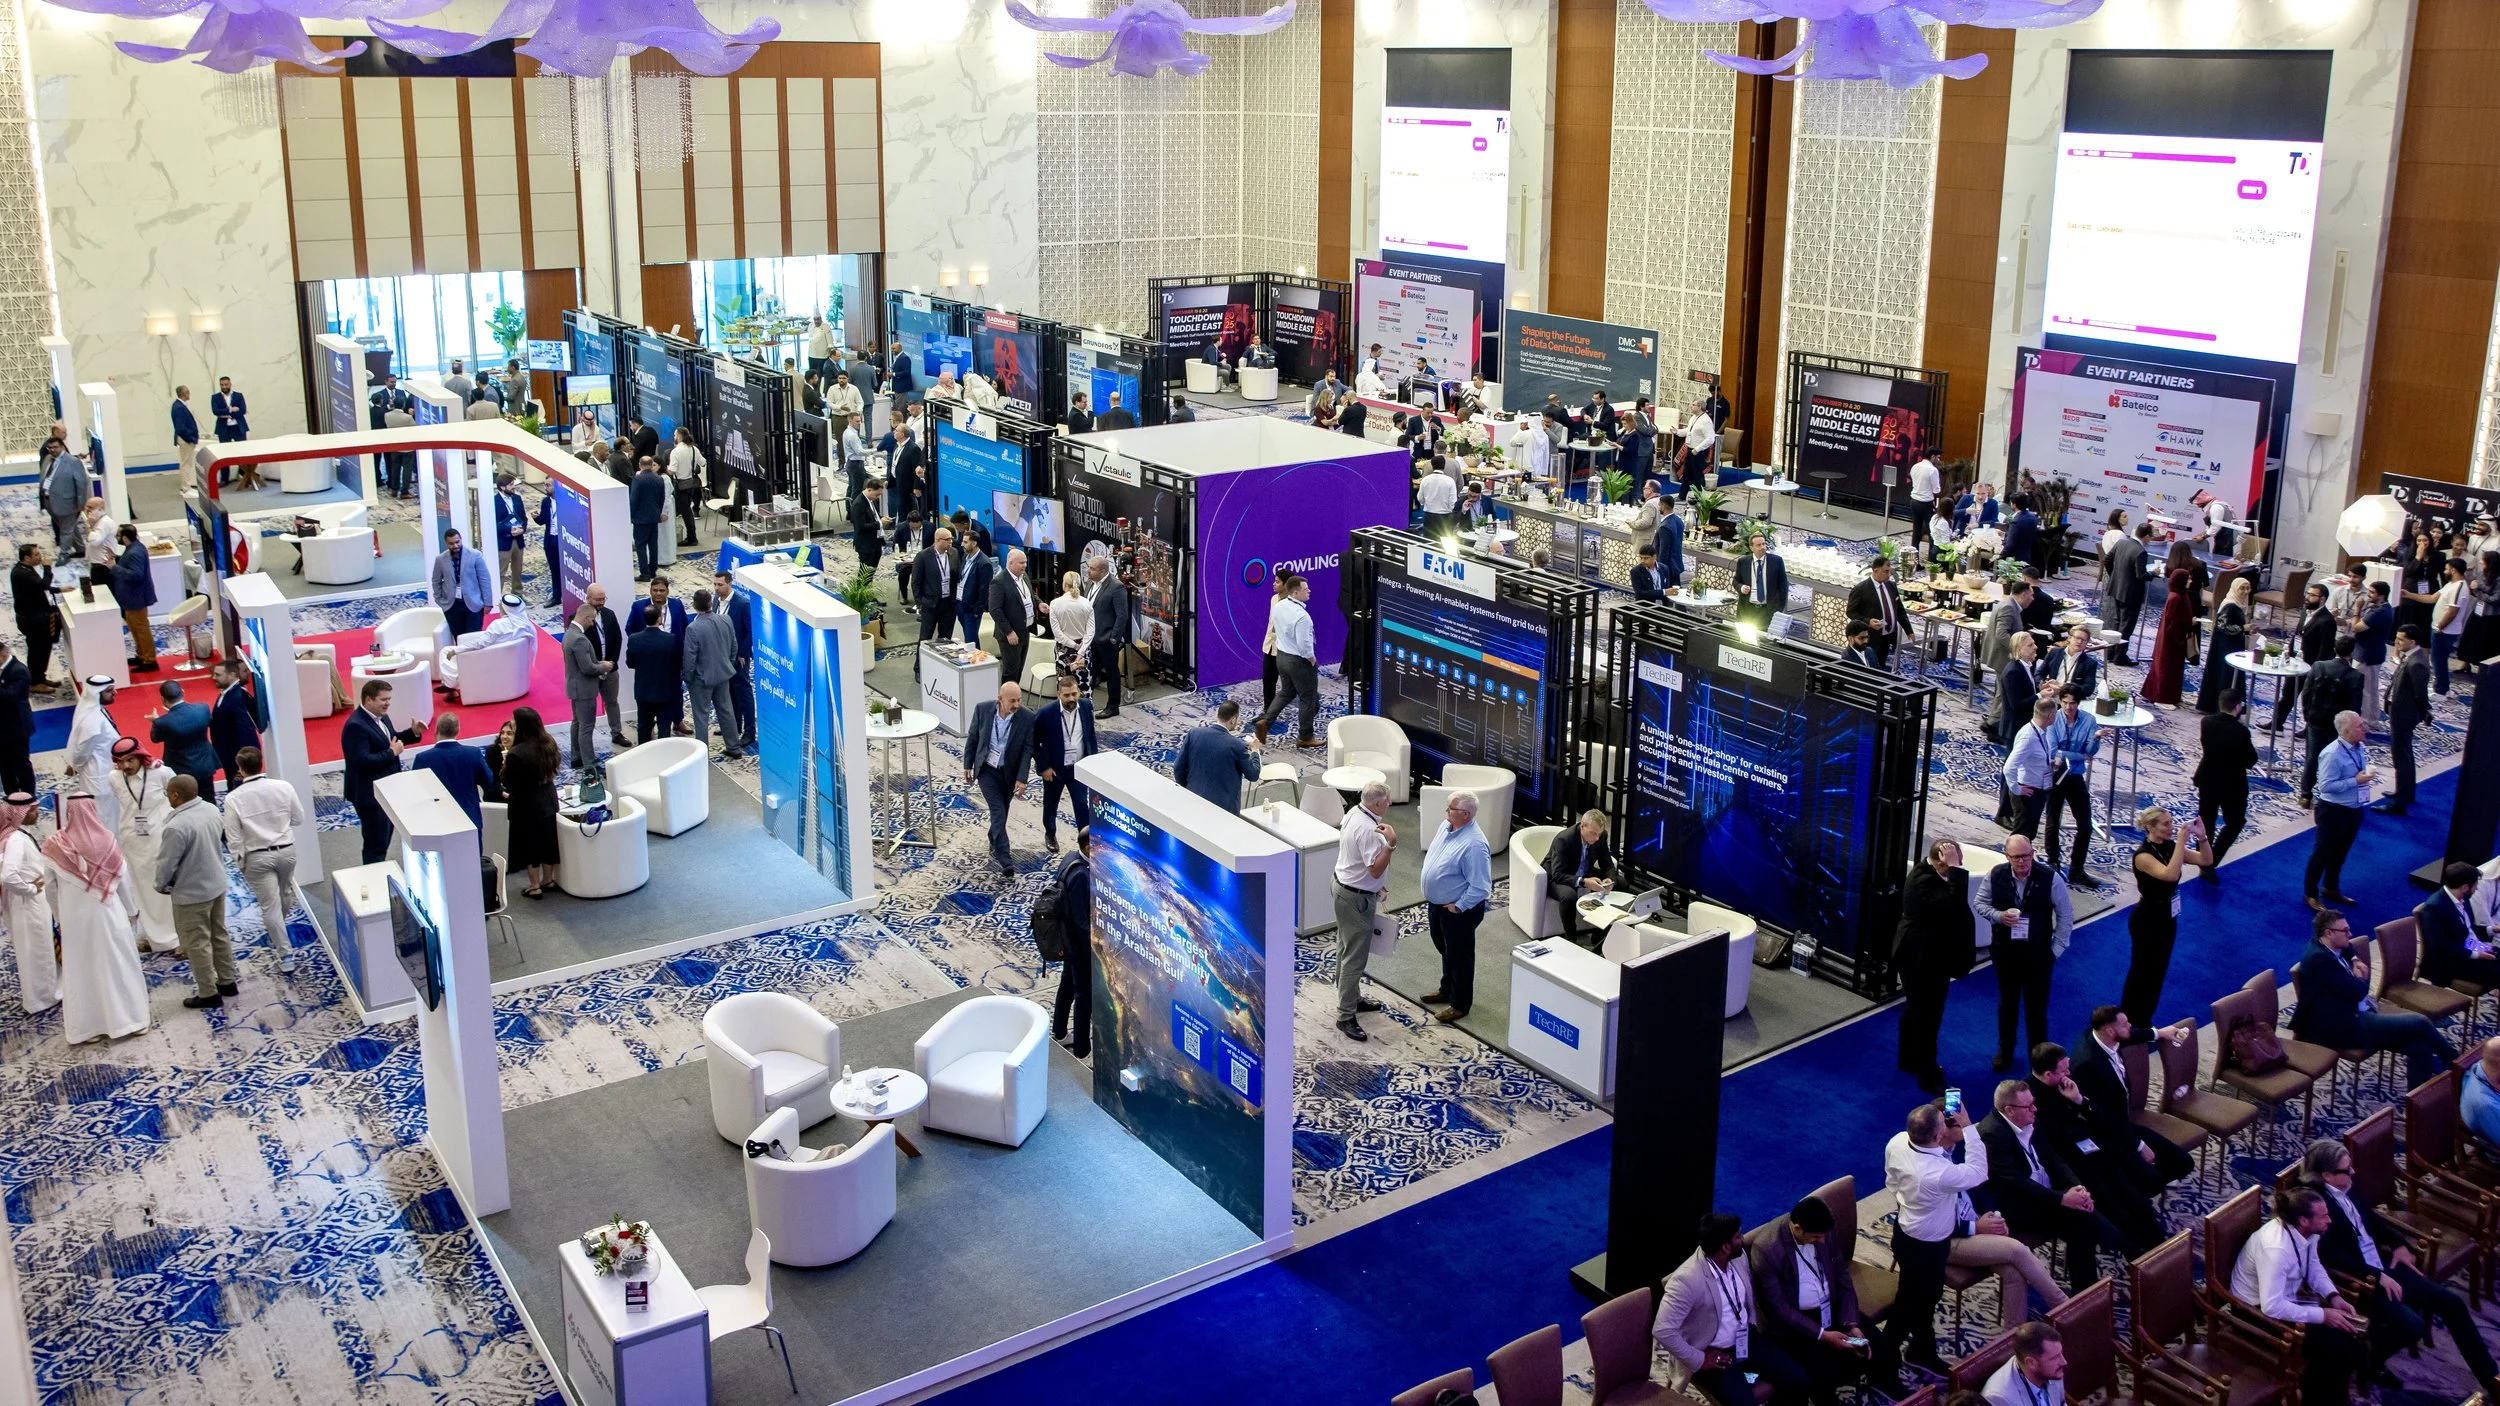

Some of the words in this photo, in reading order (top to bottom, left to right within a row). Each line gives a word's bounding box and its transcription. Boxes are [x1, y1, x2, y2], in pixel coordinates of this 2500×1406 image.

[1388, 268, 1409, 279] EVENT
[1410, 272, 1442, 282] PARTNERS
[1408, 292, 1426, 300] Batelco
[1170, 312, 1223, 324] TOUCHDOWN
[1170, 324, 1200, 334] MIDDLE
[1202, 322, 1222, 330] EAST
[1224, 320, 1234, 328] 25
[1276, 312, 1315, 324] TOUCHDOWN
[1276, 320, 1298, 330] MIDDLE
[1299, 324, 1314, 333] EAST
[1083, 338, 1113, 350] GRUNDFOS
[1521, 326, 1550, 340] Shaping
[1551, 330, 1564, 340] the
[1565, 333, 1590, 345] Future
[1618, 336, 1636, 347] DMC
[1521, 337, 1529, 346] of
[1530, 338, 1547, 349] Data
[1548, 341, 1574, 354] Centre
[1575, 346, 1606, 361] Delivery
[635, 369, 657, 390] POWER
[1076, 372, 1090, 380] impact
[2086, 364, 2127, 380] EVENT
[2130, 372, 2195, 389] PARTNERS
[1811, 405, 1881, 425] TOUCHDOWN
[2122, 399, 2159, 413] Batelco
[1366, 411, 1387, 425] Shaping
[1371, 422, 1386, 432] Data
[1810, 417, 1850, 432] MIDDLE
[1851, 424, 1879, 437] EAST
[1883, 416, 1897, 428] 20
[966, 422, 987, 437] Envicool
[1882, 430, 1896, 440] 25
[1808, 438, 1833, 449] Meeting
[2170, 435, 2203, 447] HAWK
[1092, 454, 1132, 479] Victaulic
[1068, 490, 1086, 511] YOUR
[2416, 490, 2456, 508] friendly
[1069, 508, 1098, 533] PROJECT
[562, 526, 590, 560] Powering
[563, 550, 583, 577] Future
[584, 566, 591, 582] of
[1272, 554, 1339, 576] GOWLING
[1424, 552, 1464, 580] EATON
[1406, 583, 1434, 601] Powering
[1435, 592, 1469, 610] AI-enabled
[1470, 604, 1495, 619] systems
[1495, 611, 1512, 624] from
[1512, 619, 1527, 629] grid
[1528, 622, 1535, 631] to
[758, 639, 780, 666] Knowing
[780, 656, 794, 672] what
[1725, 652, 1766, 675] TechRE
[759, 656, 780, 678] matters.
[1644, 665, 1678, 686] TechRE
[924, 678, 958, 707] Victaulic
[1640, 722, 1646, 732] A
[1647, 726, 1674, 741] unique
[1740, 758, 1752, 769] for
[1754, 764, 1788, 784] existing
[1639, 744, 1676, 763] occupiers
[1678, 758, 1694, 769] and
[1695, 763, 1735, 784] investors.
[1640, 734, 1654, 744] and
[1655, 739, 1701, 762] prospective
[1703, 757, 1720, 769] data
[1723, 764, 1749, 779] centre
[1751, 774, 1784, 794] owners,
[1644, 765, 1658, 775] United
[1659, 770, 1678, 783] Kingdom
[1643, 776, 1662, 788] Kingdom
[1669, 786, 1686, 797] Bahrain
[1104, 802, 1116, 815] Gulf
[1116, 808, 1130, 824] Data
[1131, 817, 1150, 836] Centre
[1104, 812, 1137, 838] Association
[1095, 878, 1137, 915] Welcome
[1139, 907, 1149, 923] to
[1151, 917, 1167, 935] the
[1171, 929, 1209, 962] Largest
[1096, 897, 1117, 920] Data
[1120, 912, 1153, 942] Centre
[1153, 935, 1210, 984] Community
[1096, 914, 1105, 929] in
[1106, 923, 1121, 941] the
[1124, 934, 1161, 968] Arabian
[1163, 962, 1185, 983] Gulf
[1175, 1004, 1190, 1018] Become
[1194, 1018, 1209, 1032] sponsor
[1192, 1022, 1204, 1035] GDCA
[1535, 1011, 1574, 1042] TechRE
[1221, 1036, 1237, 1051] Become
[1241, 1051, 1258, 1065] member
[1239, 1057, 1251, 1069] GDCA
